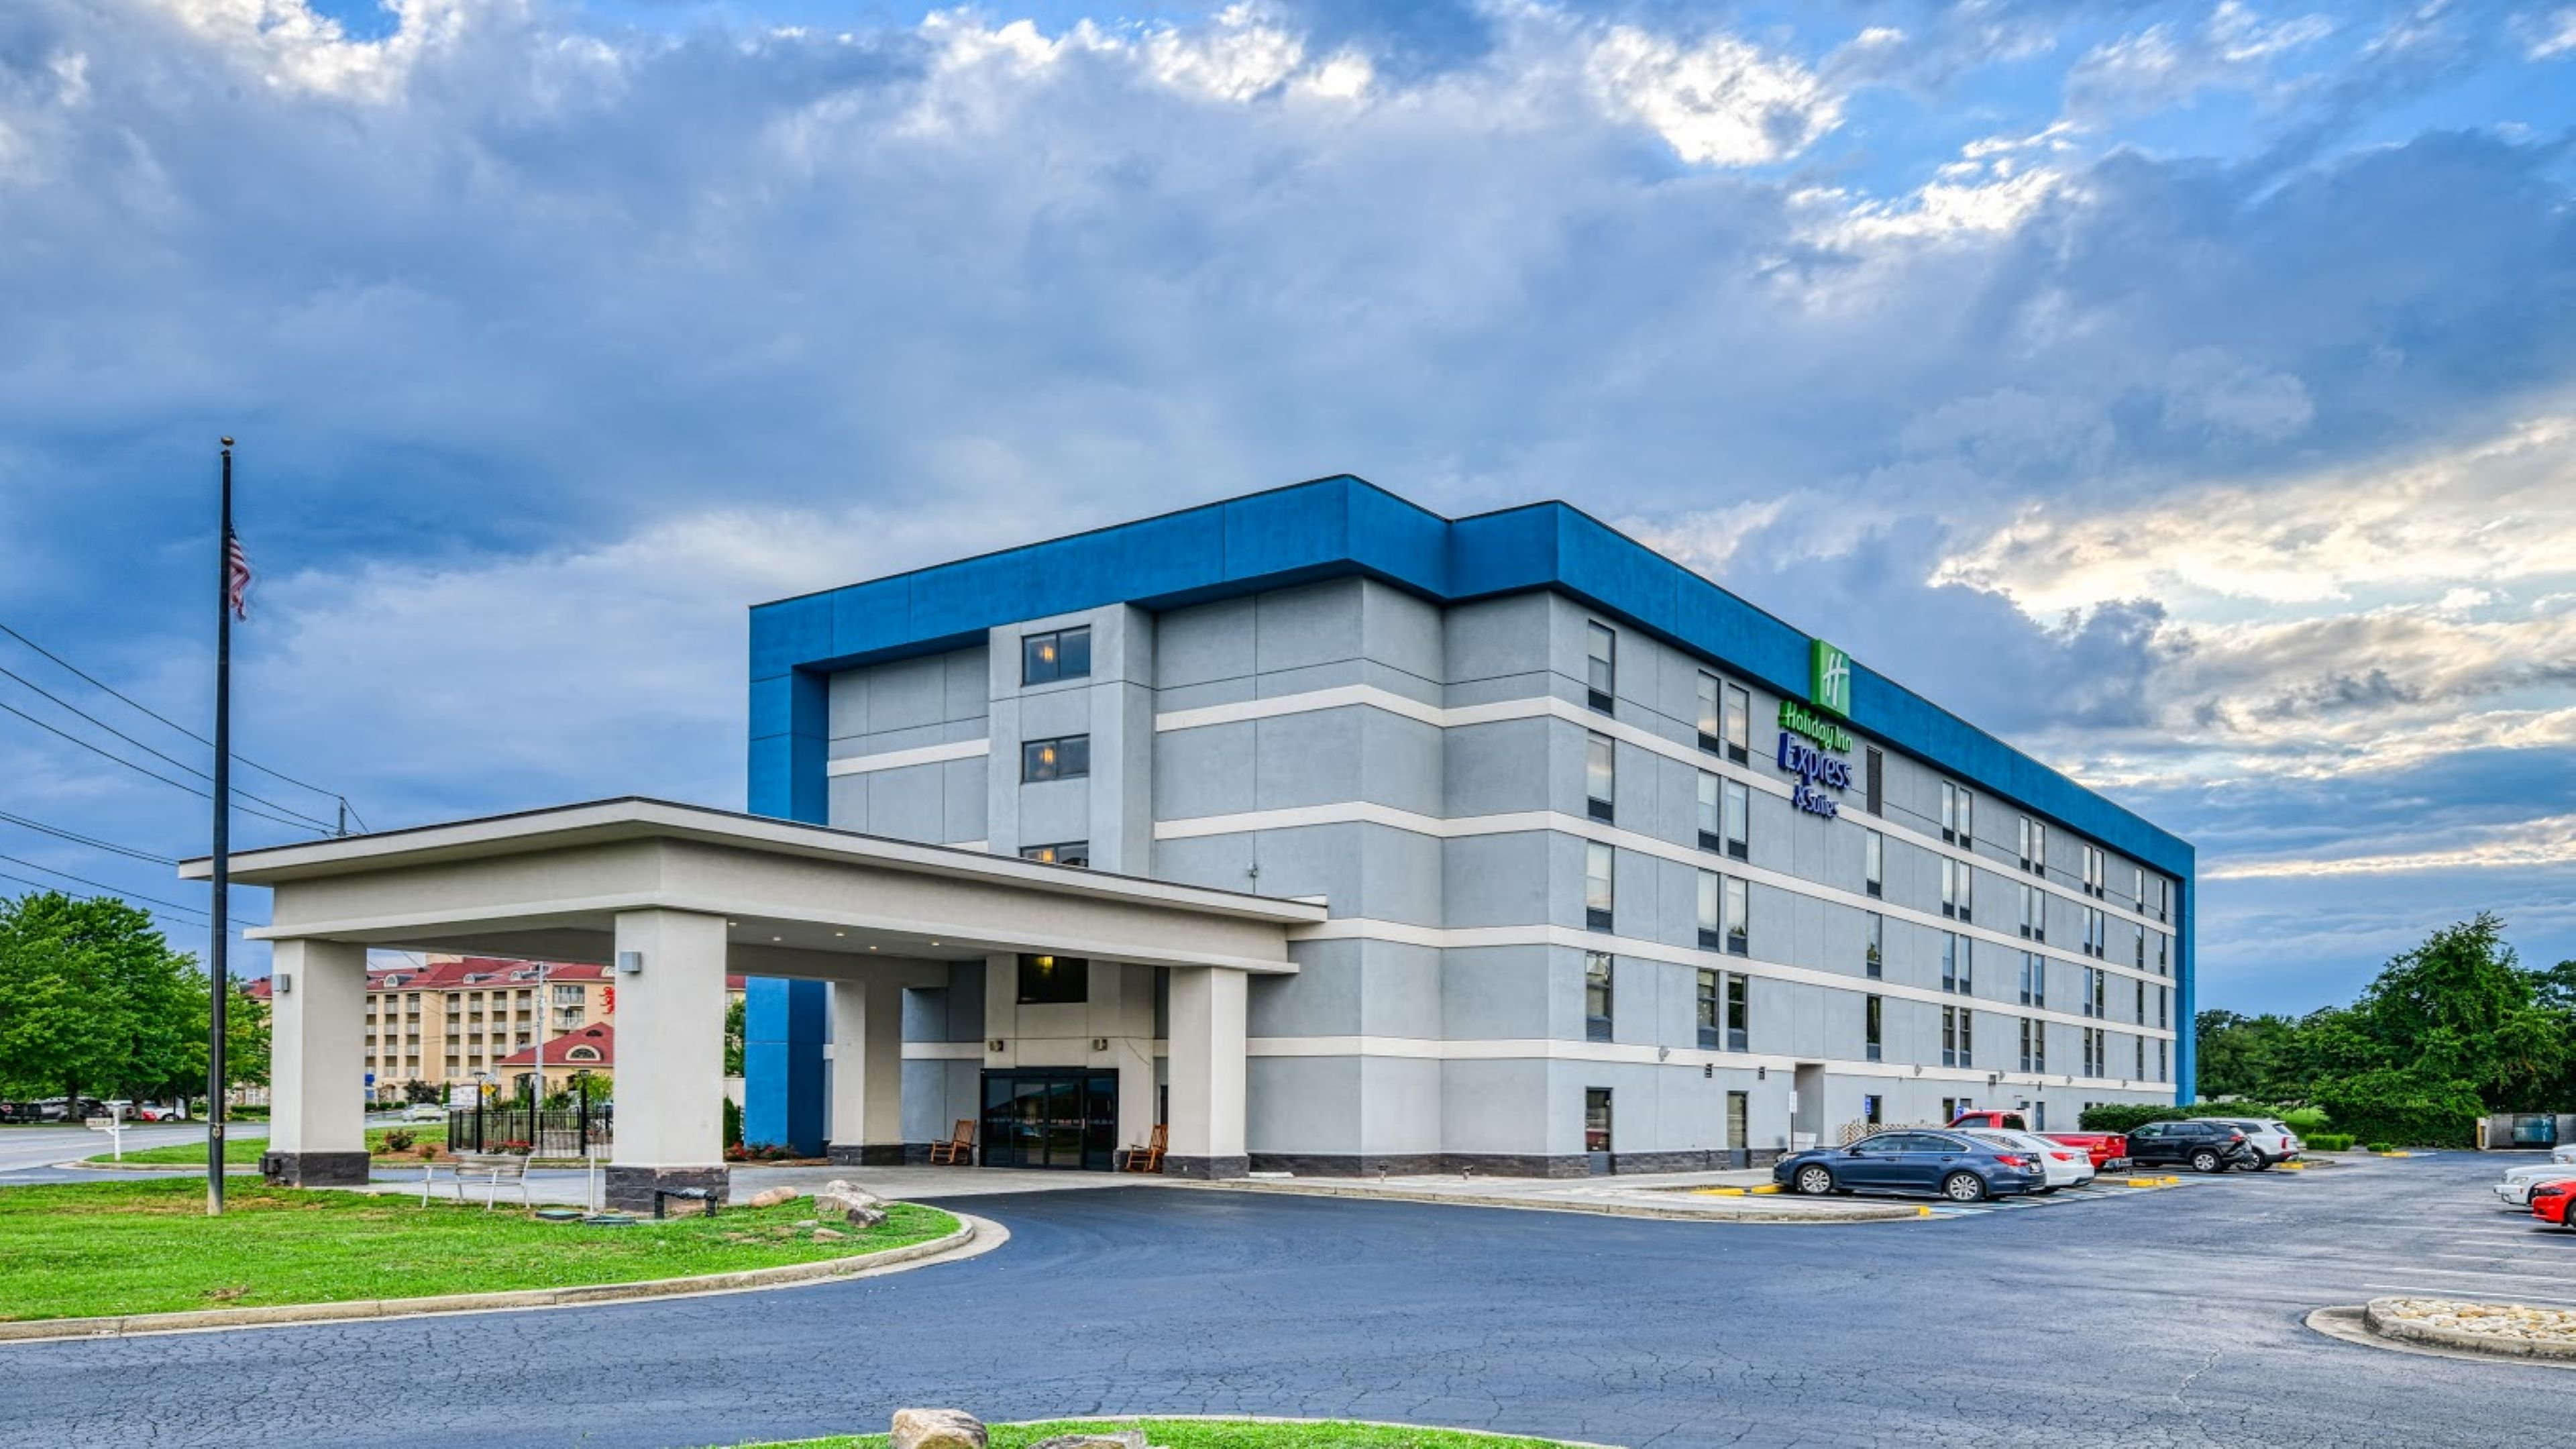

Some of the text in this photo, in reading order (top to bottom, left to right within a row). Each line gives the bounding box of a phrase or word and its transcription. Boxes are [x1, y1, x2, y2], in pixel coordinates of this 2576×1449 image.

[1822, 652, 1850, 706] H
[1783, 700, 1852, 752] Holiday Inn
[1784, 732, 1852, 790] Express
